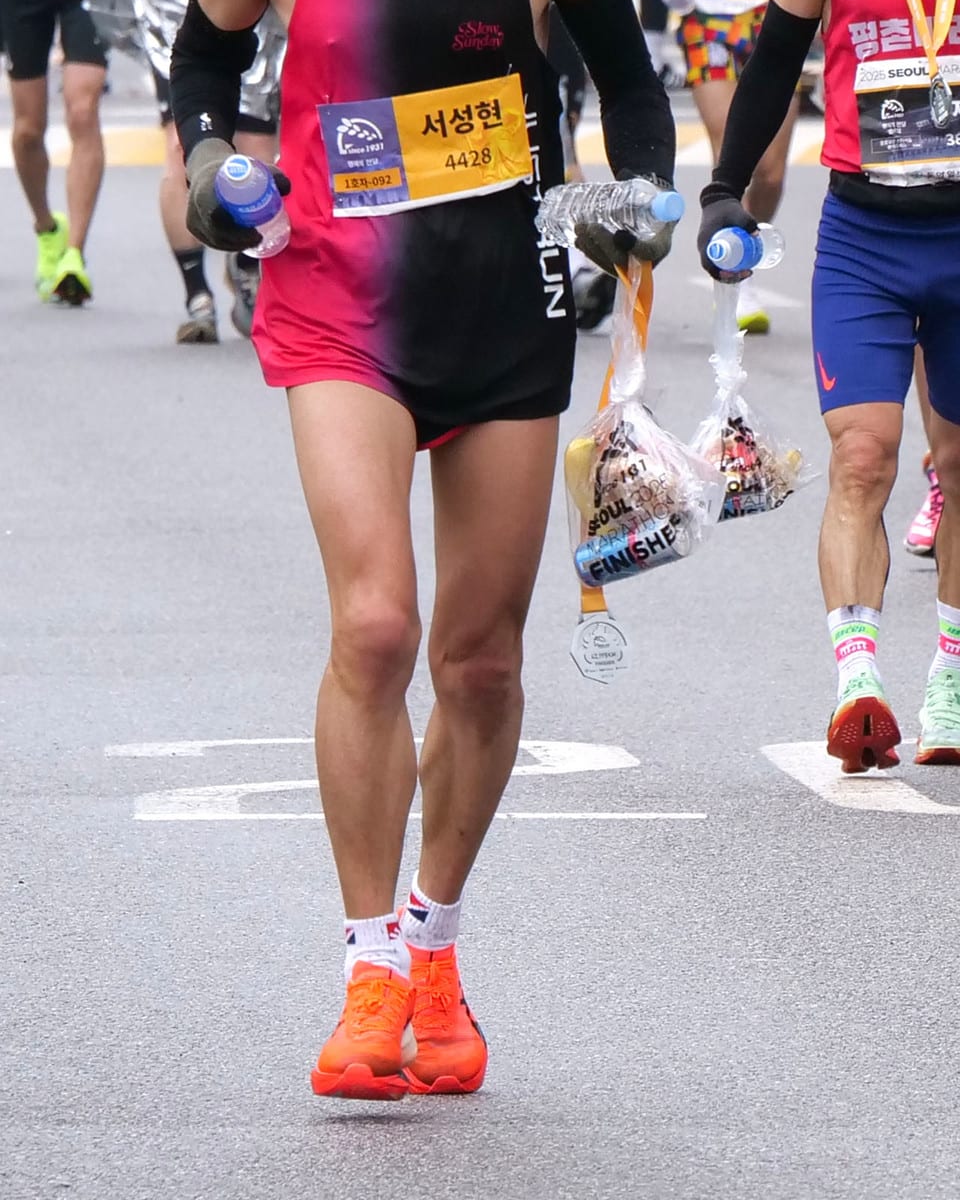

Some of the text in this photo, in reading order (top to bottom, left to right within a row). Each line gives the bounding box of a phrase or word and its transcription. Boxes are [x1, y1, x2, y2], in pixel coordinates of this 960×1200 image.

[859, 69, 887, 83] 2025
[887, 66, 930, 79] SEOUL
[421, 98, 504, 139] 서성현
[445, 147, 493, 171] 4428
